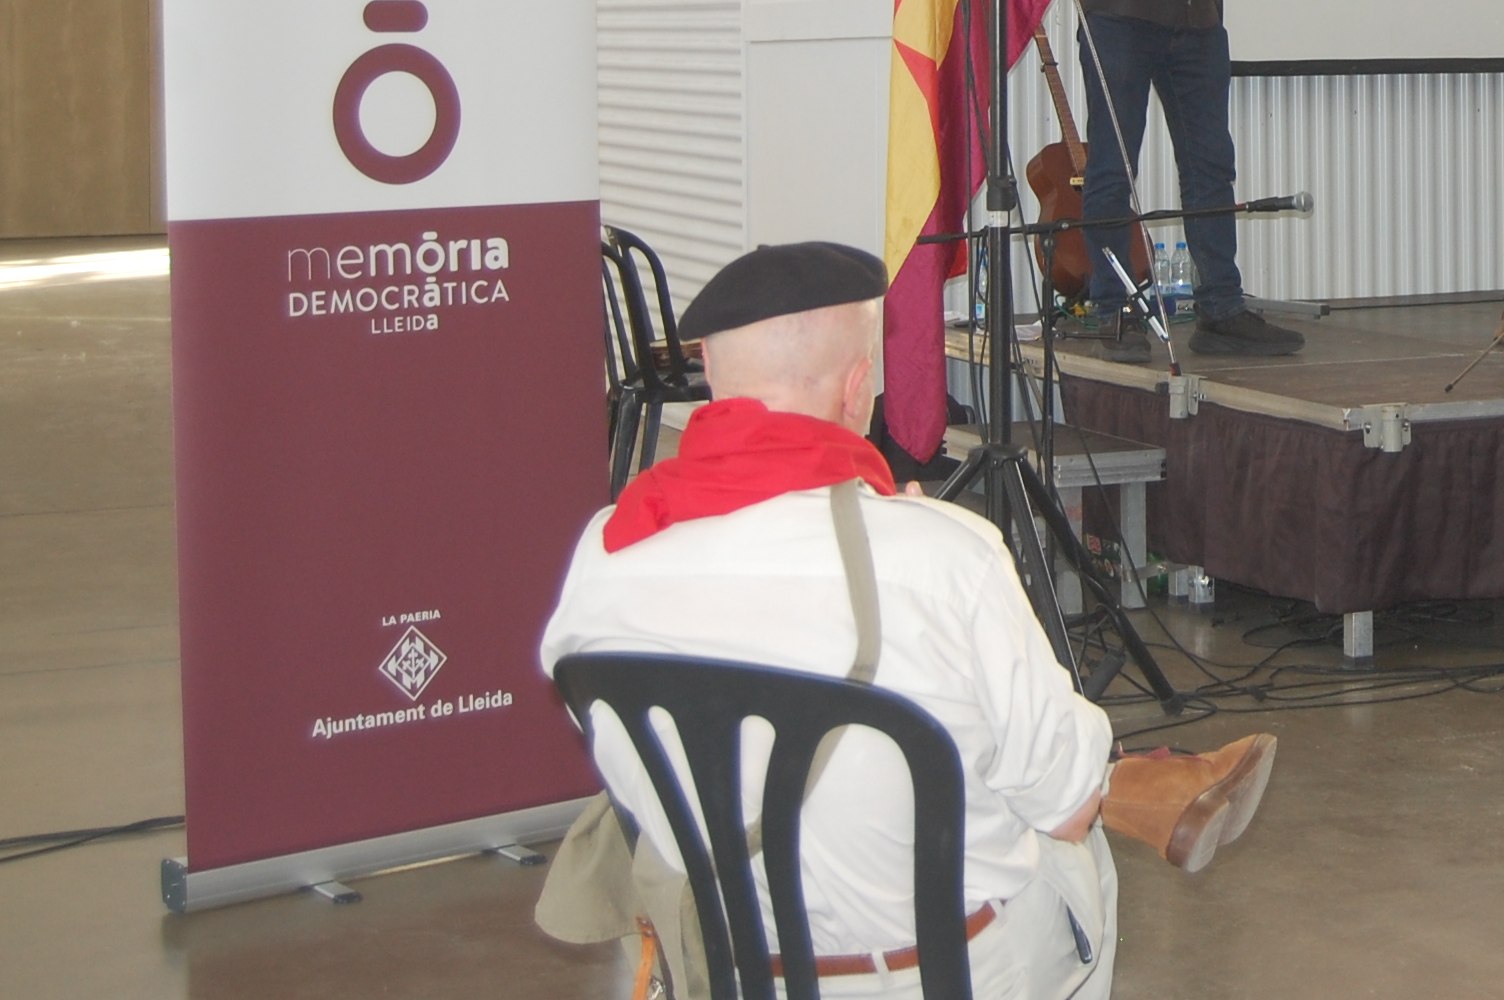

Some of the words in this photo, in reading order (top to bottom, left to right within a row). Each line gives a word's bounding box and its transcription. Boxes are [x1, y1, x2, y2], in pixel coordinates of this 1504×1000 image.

[382, 616, 398, 627] LA
[400, 609, 441, 625] PAERIA
[311, 703, 426, 740] Ajuntament
[430, 699, 454, 718] de
[458, 690, 514, 714] Lleida
